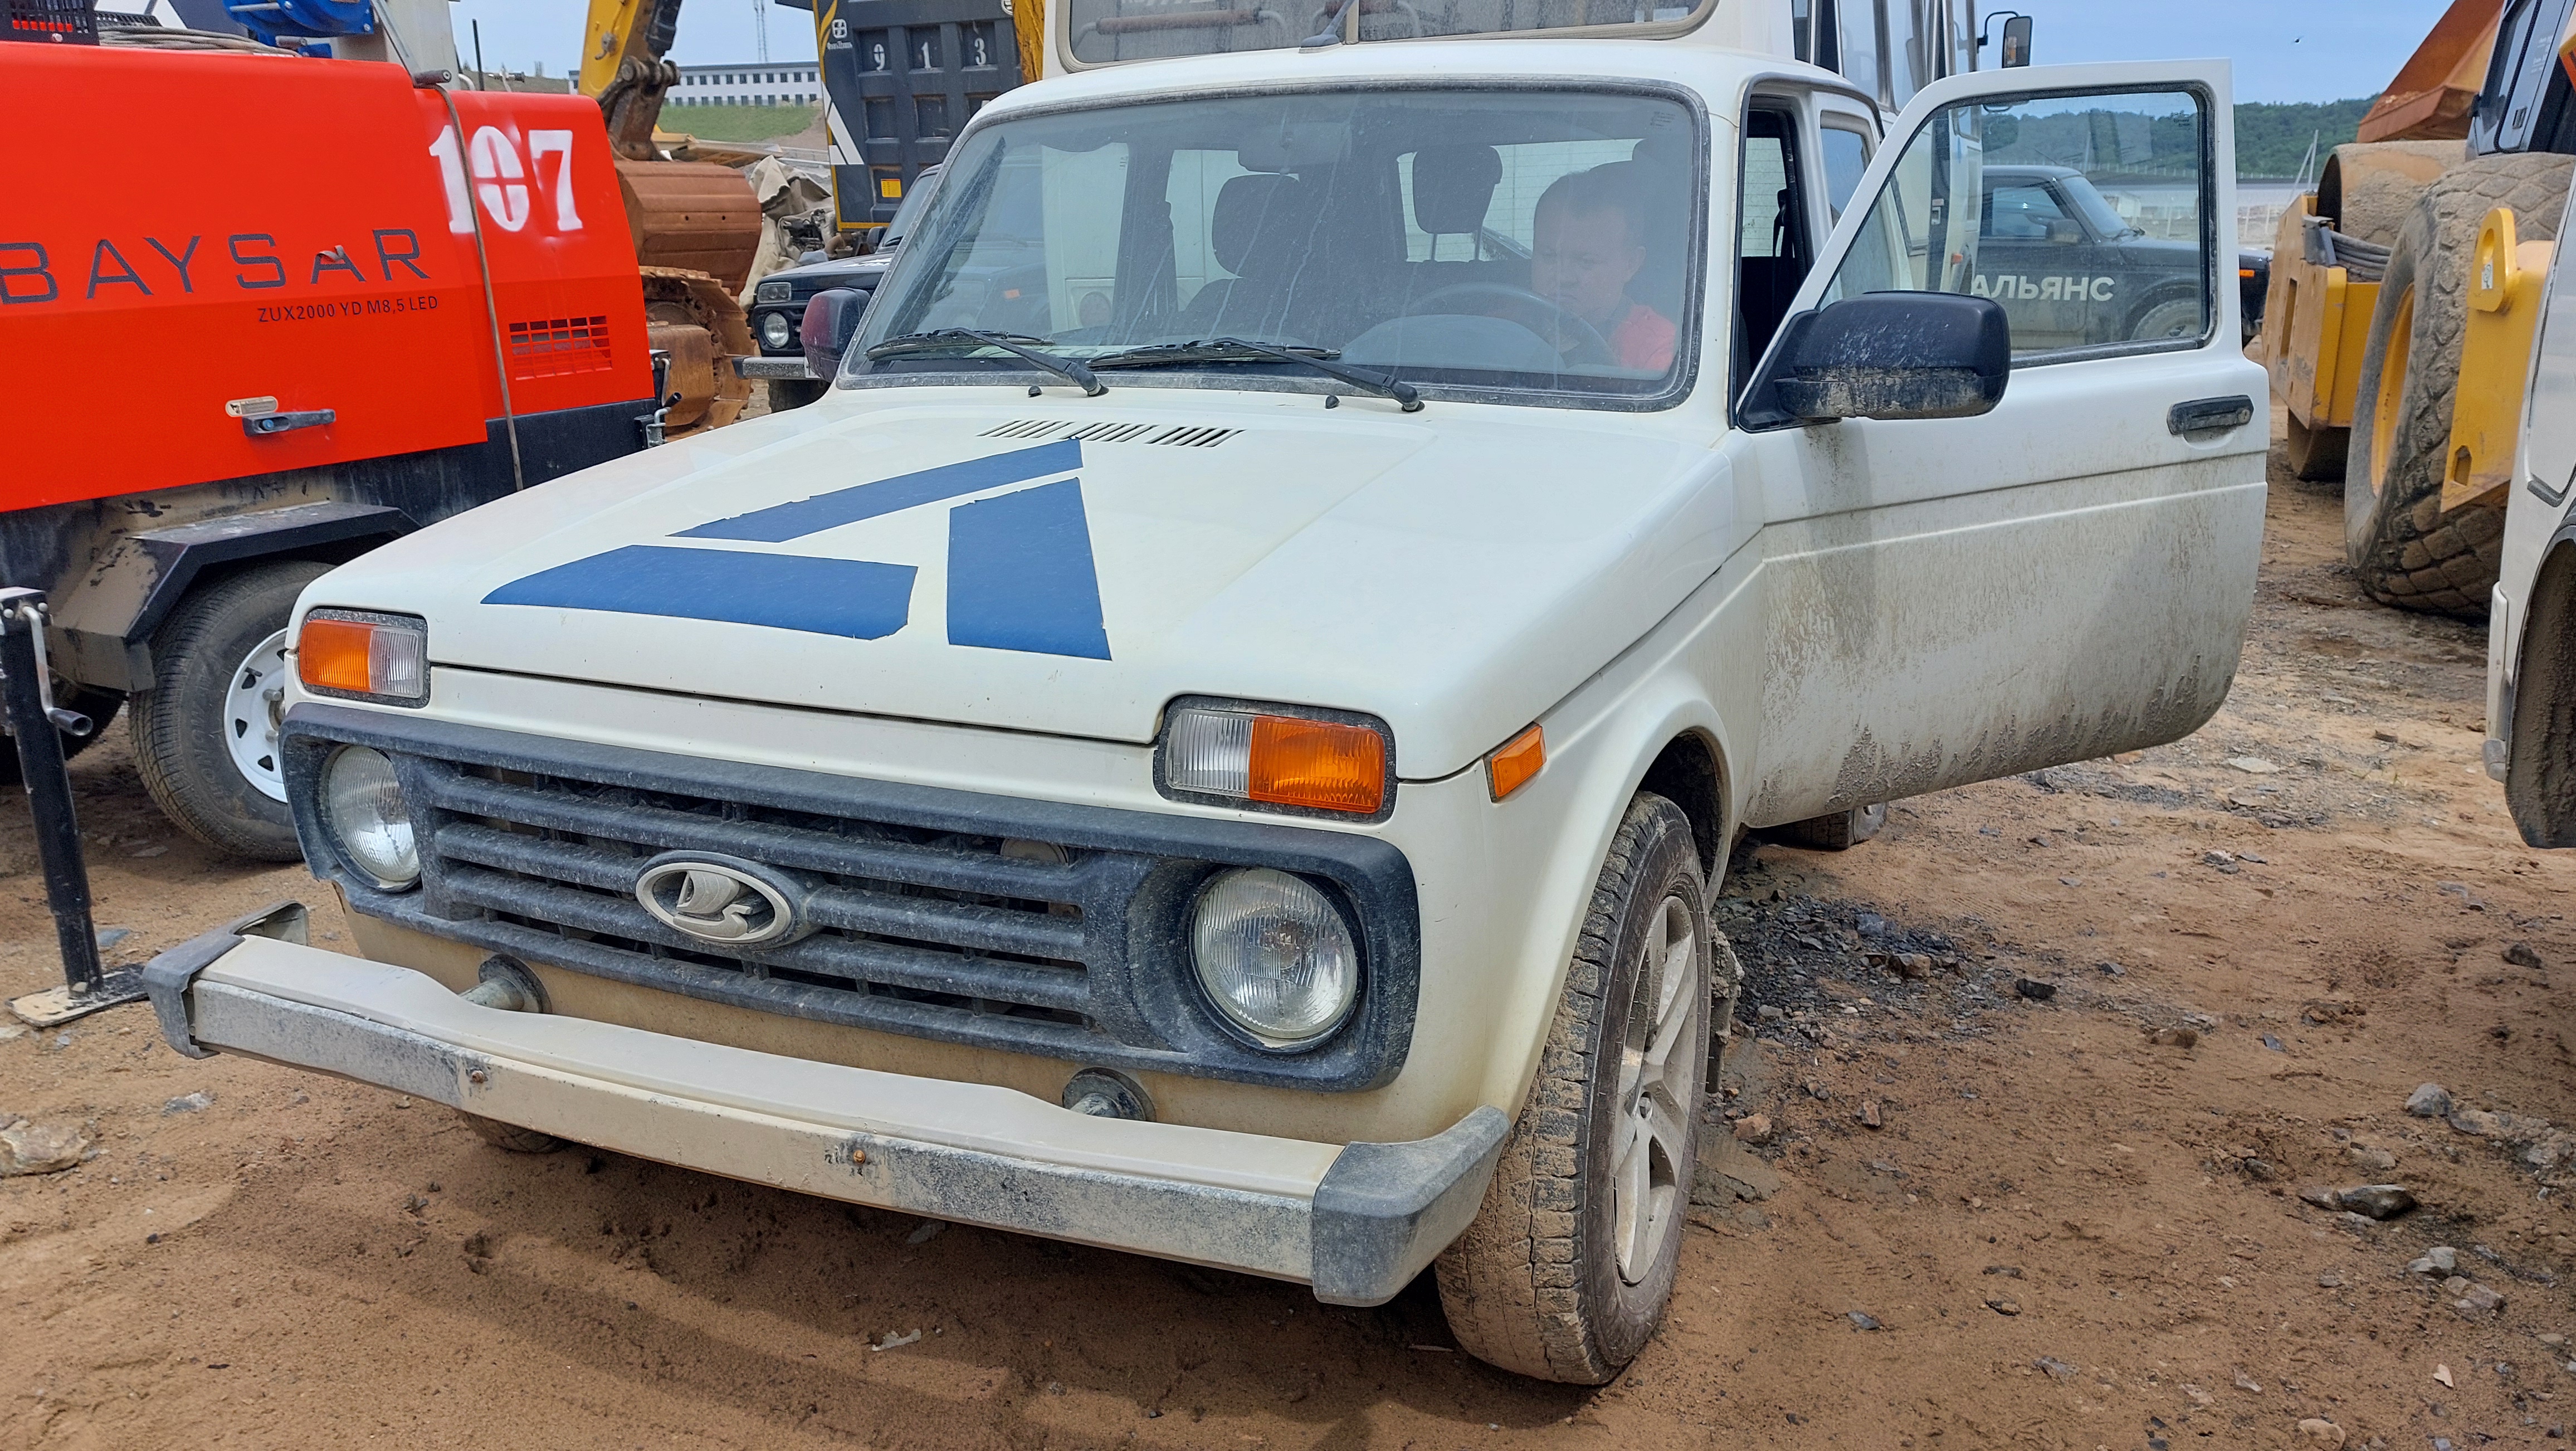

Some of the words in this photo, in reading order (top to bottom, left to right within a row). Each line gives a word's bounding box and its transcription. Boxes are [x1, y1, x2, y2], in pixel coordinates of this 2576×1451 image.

[429, 125, 582, 233] 107
[1970, 275, 2115, 301] АЛЬЯНС
[257, 304, 336, 322] ZUX2000
[339, 301, 363, 316] YD
[367, 298, 405, 314] M8,5
[409, 296, 438, 310] LED
